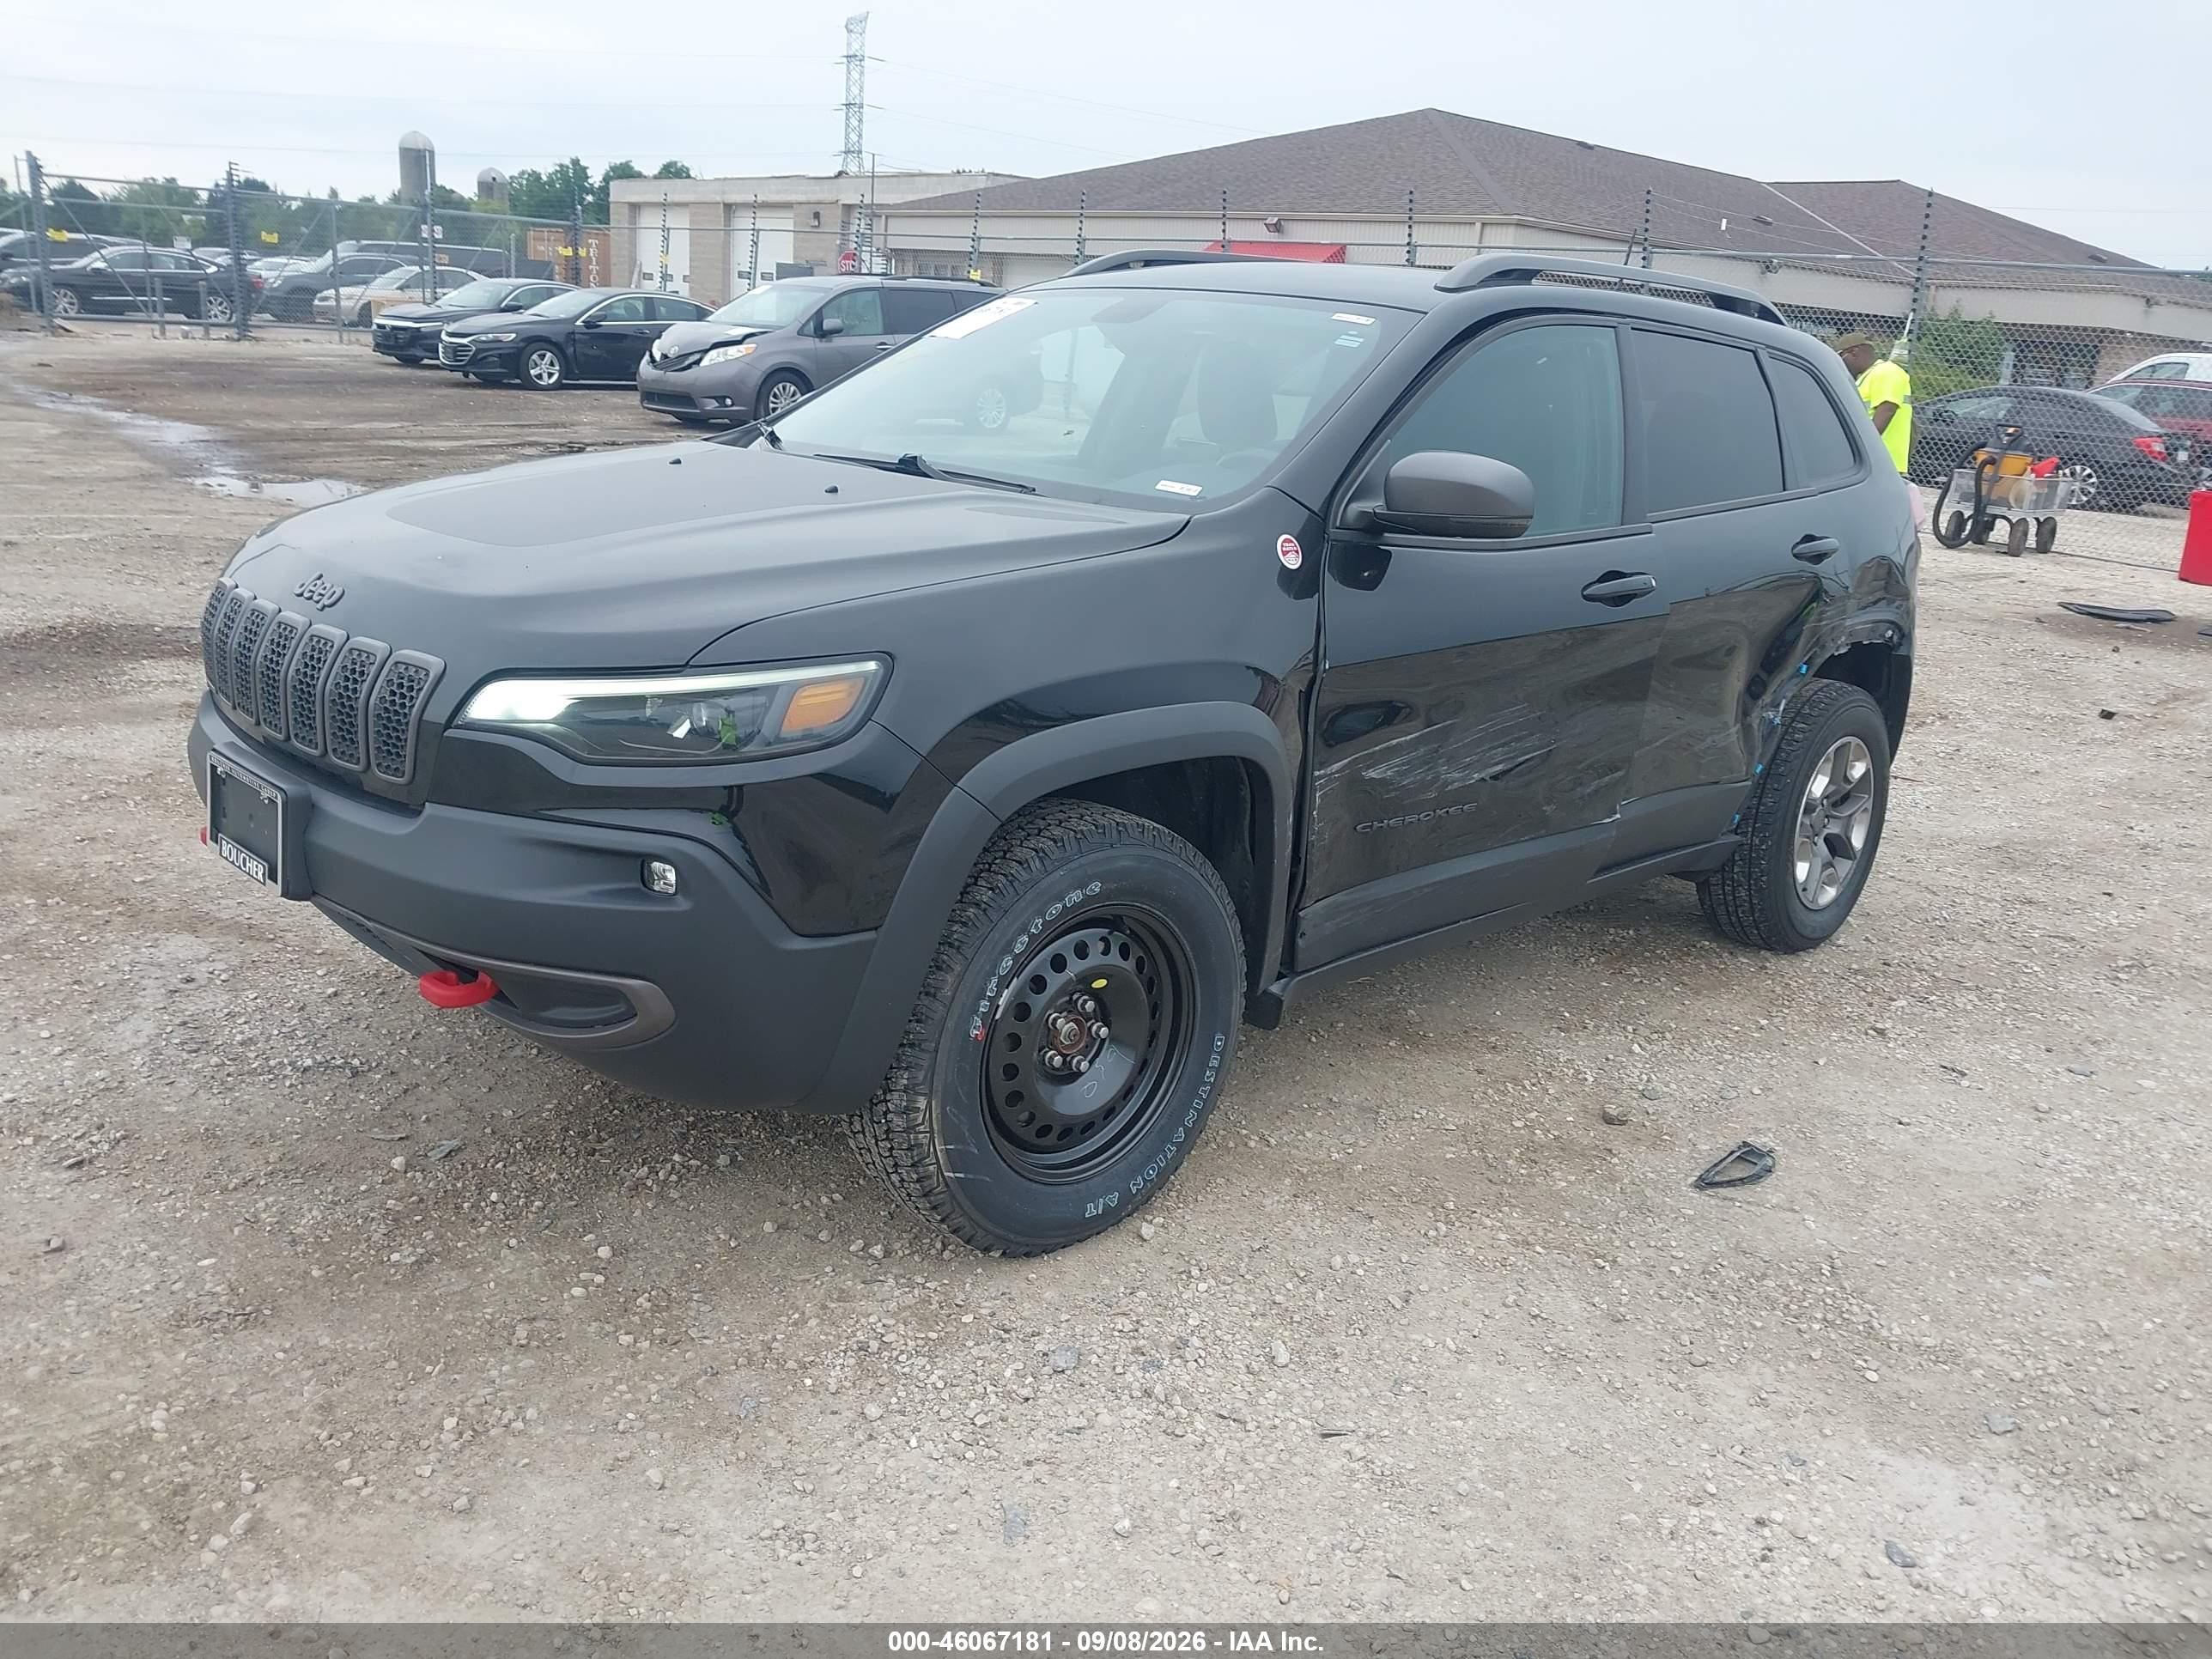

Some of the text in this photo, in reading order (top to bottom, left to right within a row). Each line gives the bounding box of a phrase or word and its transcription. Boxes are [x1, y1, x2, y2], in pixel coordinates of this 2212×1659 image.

[294, 572, 345, 611] Jeep
[1354, 803, 1478, 833] CHEROKEE
[222, 840, 264, 884] BOUCHER
[969, 881, 1103, 1041] Firestone
[1085, 1036, 1225, 1218] DESTINATION A/T
